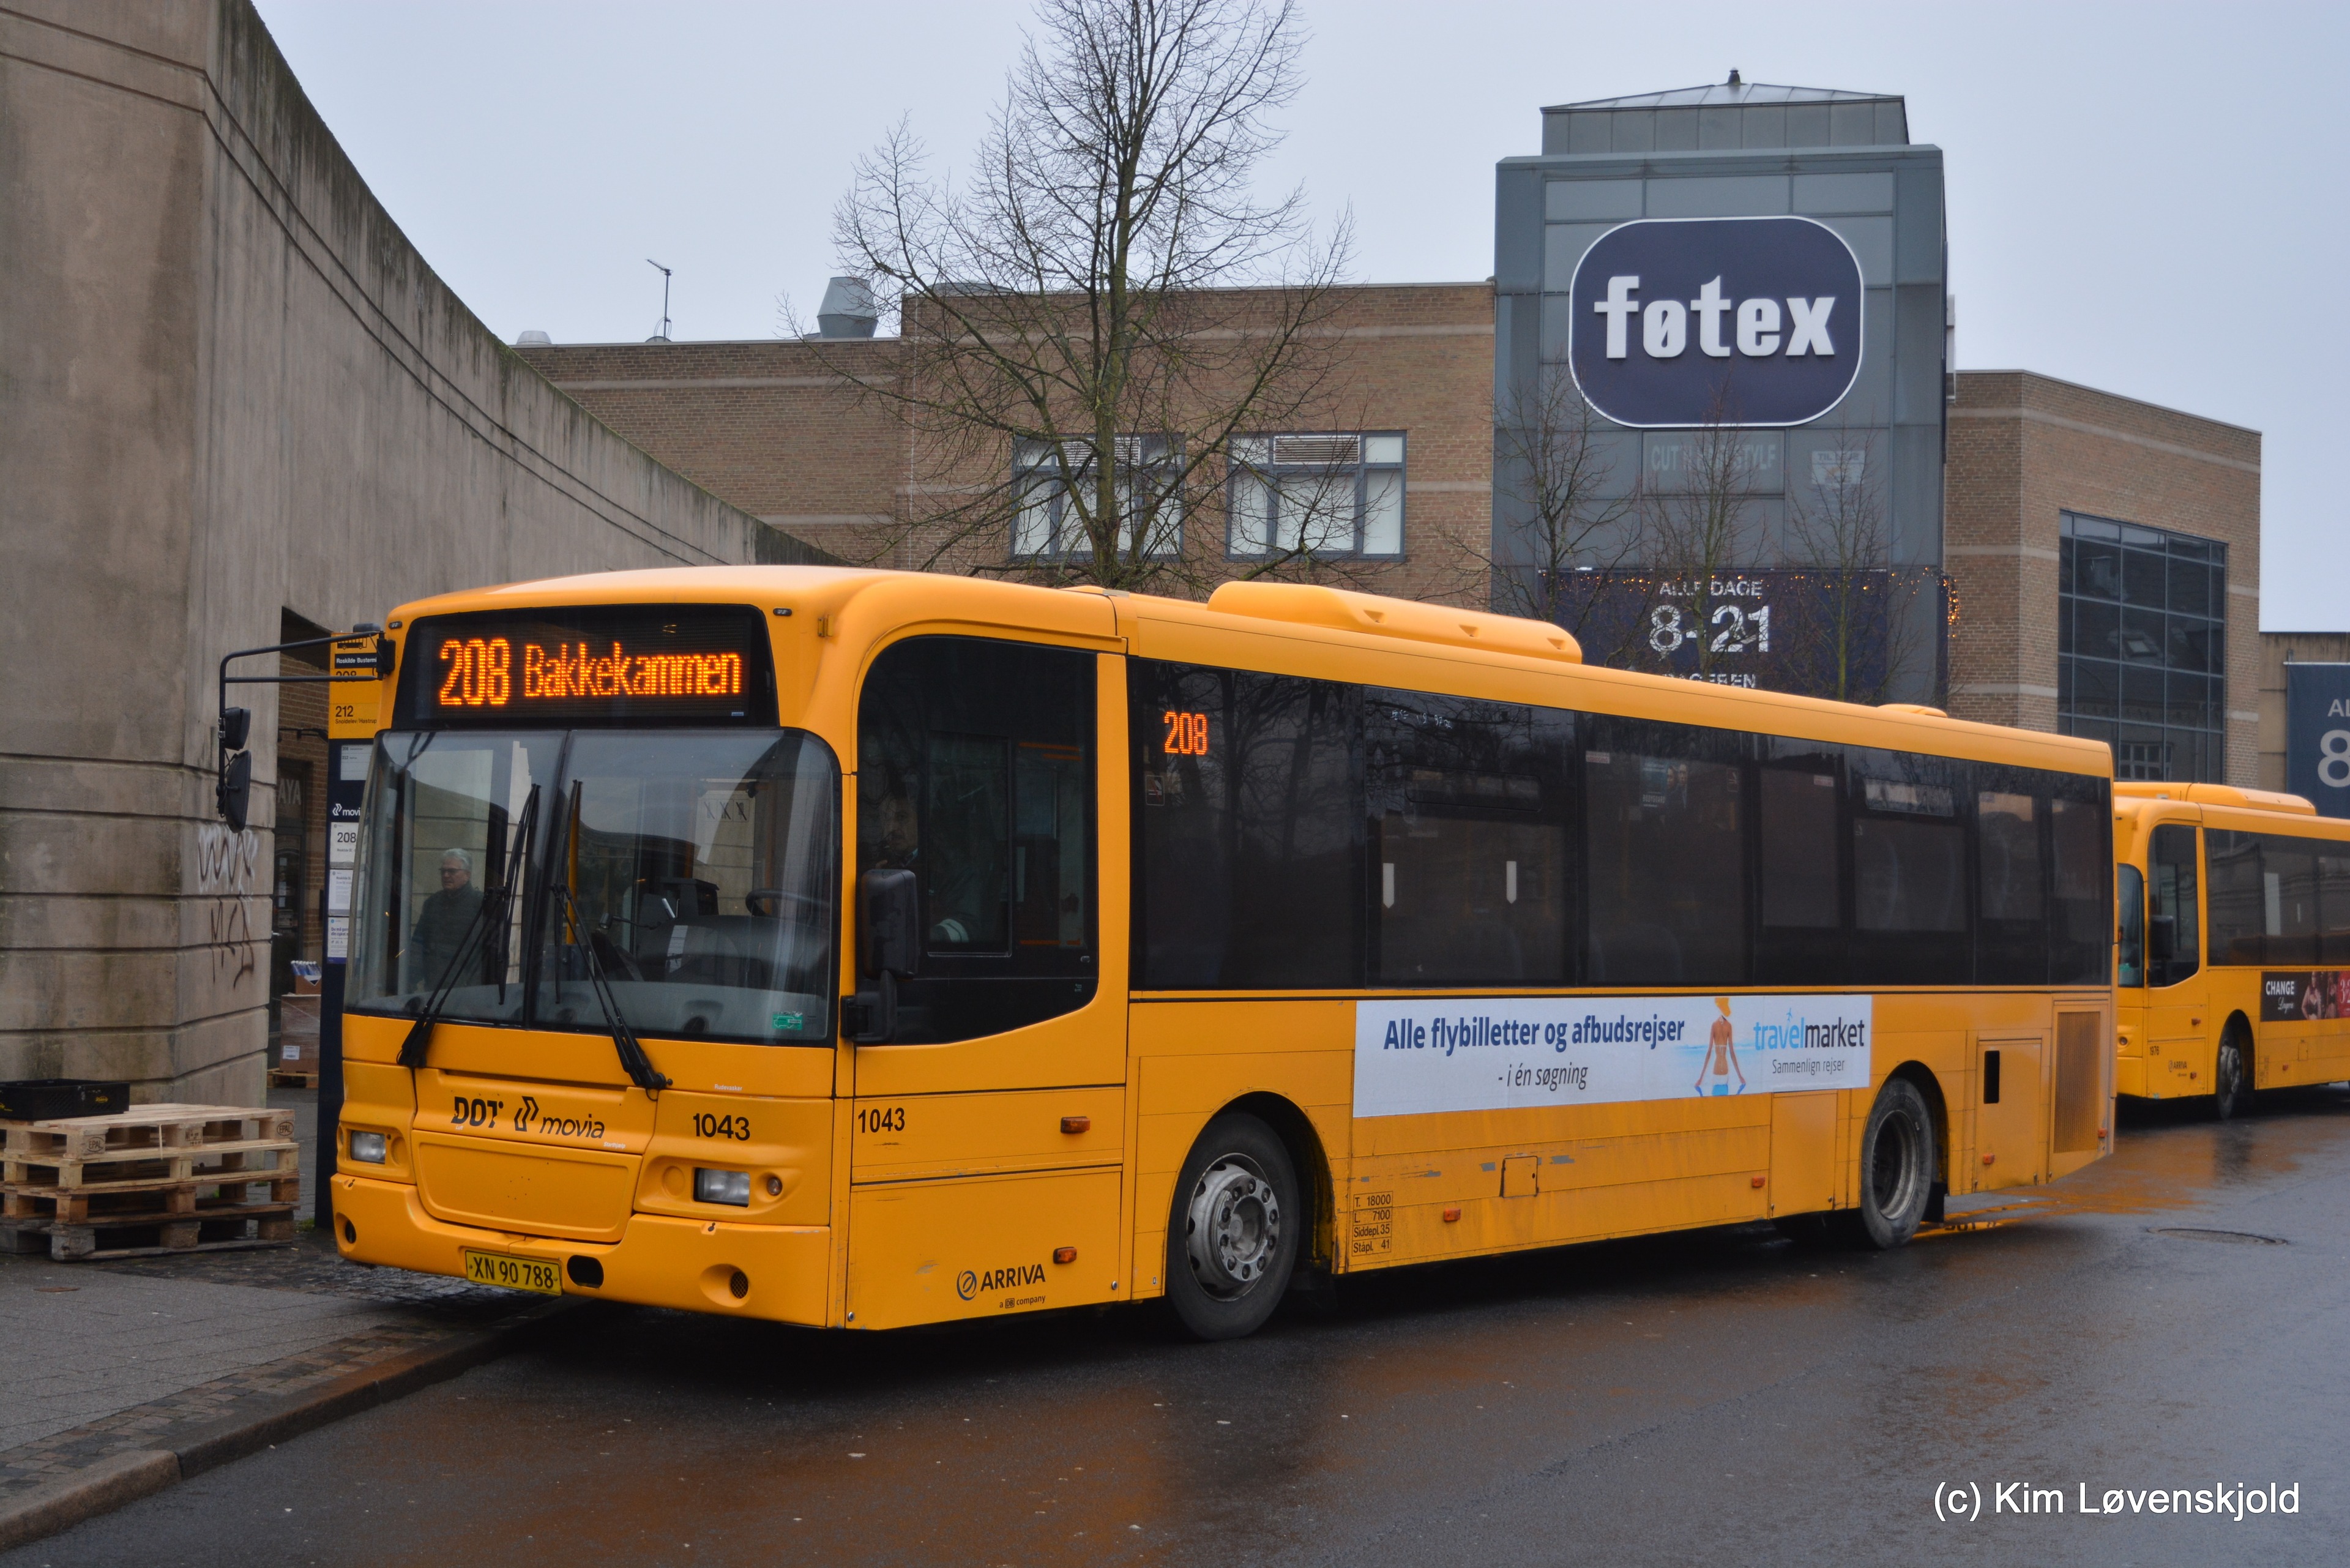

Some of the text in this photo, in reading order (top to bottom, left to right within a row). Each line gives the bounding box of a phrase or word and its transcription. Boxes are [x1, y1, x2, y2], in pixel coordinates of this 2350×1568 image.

[1594, 275, 1835, 359] føtex
[1651, 445, 1679, 471] CUT
[1710, 581, 1762, 596] DAGE
[1649, 605, 1770, 652] 8-21
[439, 638, 742, 704] 208 Bakkekammen
[335, 705, 354, 717] 212
[1164, 711, 1207, 755] 208
[337, 832, 356, 843] 208
[2266, 981, 2295, 995] CHANGE
[1383, 1014, 1685, 1057] Alle flybilletter og afbudsrejser
[1753, 1016, 1865, 1050] travelmarket
[2149, 1046, 2159, 1056] 1976
[1507, 1064, 1512, 1086] i
[1515, 1062, 1532, 1086] én
[1535, 1062, 1588, 1092] søgning
[1772, 1058, 1845, 1075] Sammenlign rejser
[539, 1113, 605, 1138] movia
[693, 1113, 750, 1141] 1043
[858, 1107, 905, 1133] 1043
[1355, 1194, 1391, 1207] T. 18000
[1354, 1209, 1390, 1223] L. 7100
[1381, 1223, 1390, 1234] 35
[1381, 1239, 1389, 1249] 41
[473, 1256, 554, 1289] XN 90 788
[980, 1264, 1046, 1291] ARRIVA
[1005, 1298, 1015, 1309] DB
[1016, 1296, 1046, 1306] company
